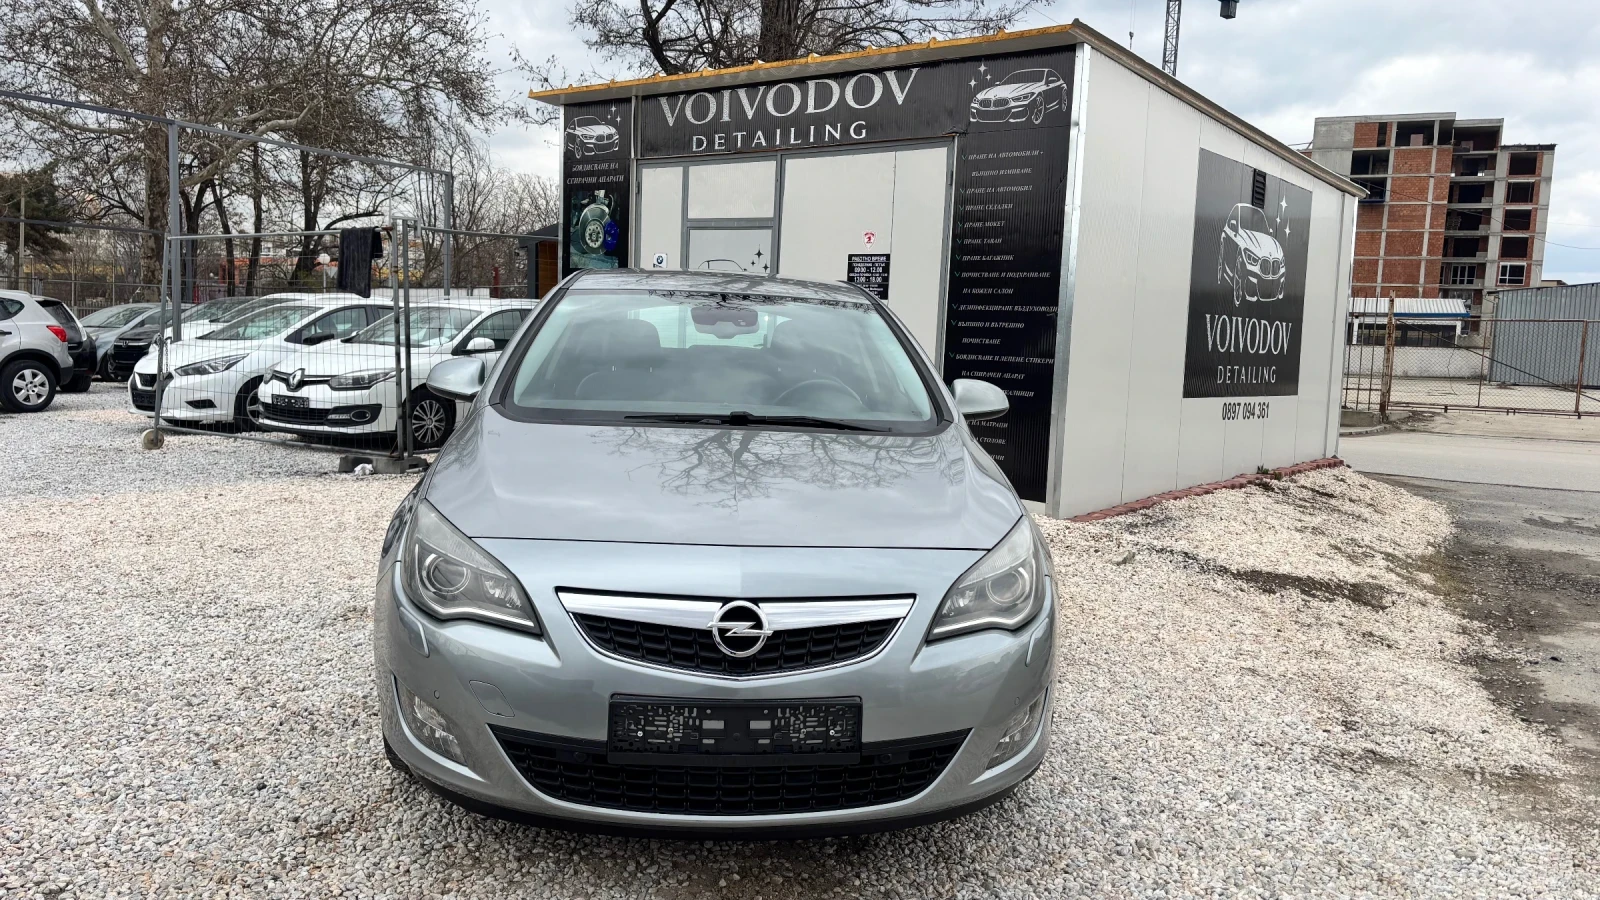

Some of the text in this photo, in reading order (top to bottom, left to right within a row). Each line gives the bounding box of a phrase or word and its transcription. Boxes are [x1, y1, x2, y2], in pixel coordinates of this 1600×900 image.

[658, 67, 920, 127] VOIVODOV
[692, 121, 867, 152] DETAILING
[998, 150, 1040, 158] АВТОМОБИЛИ
[572, 162, 610, 172] БОЯДИСВАНЕ
[566, 176, 597, 184] СПИРАЧНИ
[1205, 314, 1292, 355] VOIVODOV
[1217, 366, 1277, 384] DETAILING
[1222, 402, 1270, 420] 0897 094 361
